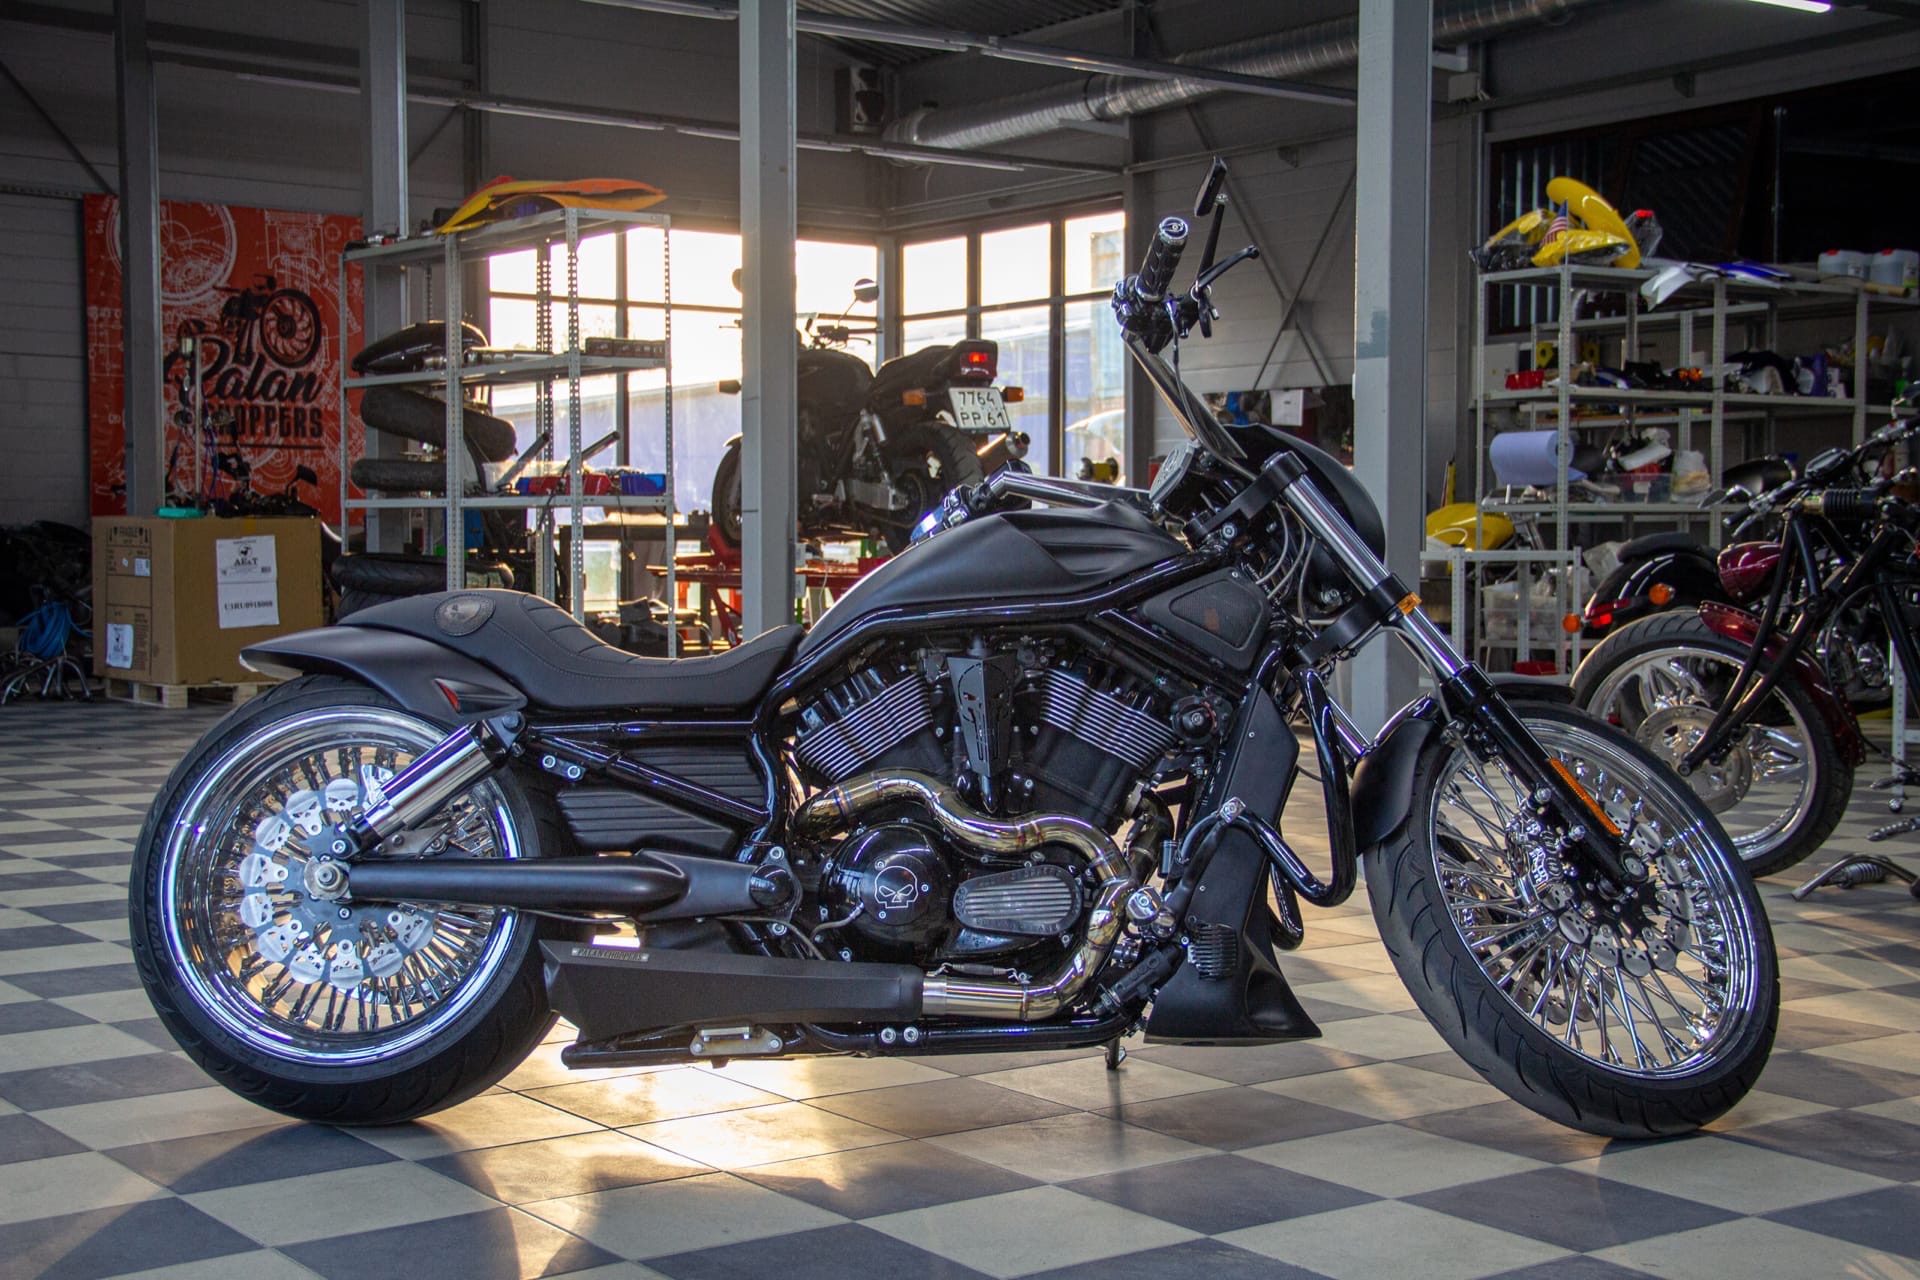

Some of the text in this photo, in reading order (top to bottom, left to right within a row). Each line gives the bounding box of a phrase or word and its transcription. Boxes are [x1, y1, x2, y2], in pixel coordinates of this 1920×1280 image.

[163, 338, 323, 406] Palan
[958, 391, 995, 406] 7764
[960, 411, 1006, 427] PP 61
[147, 904, 167, 964] AVON
